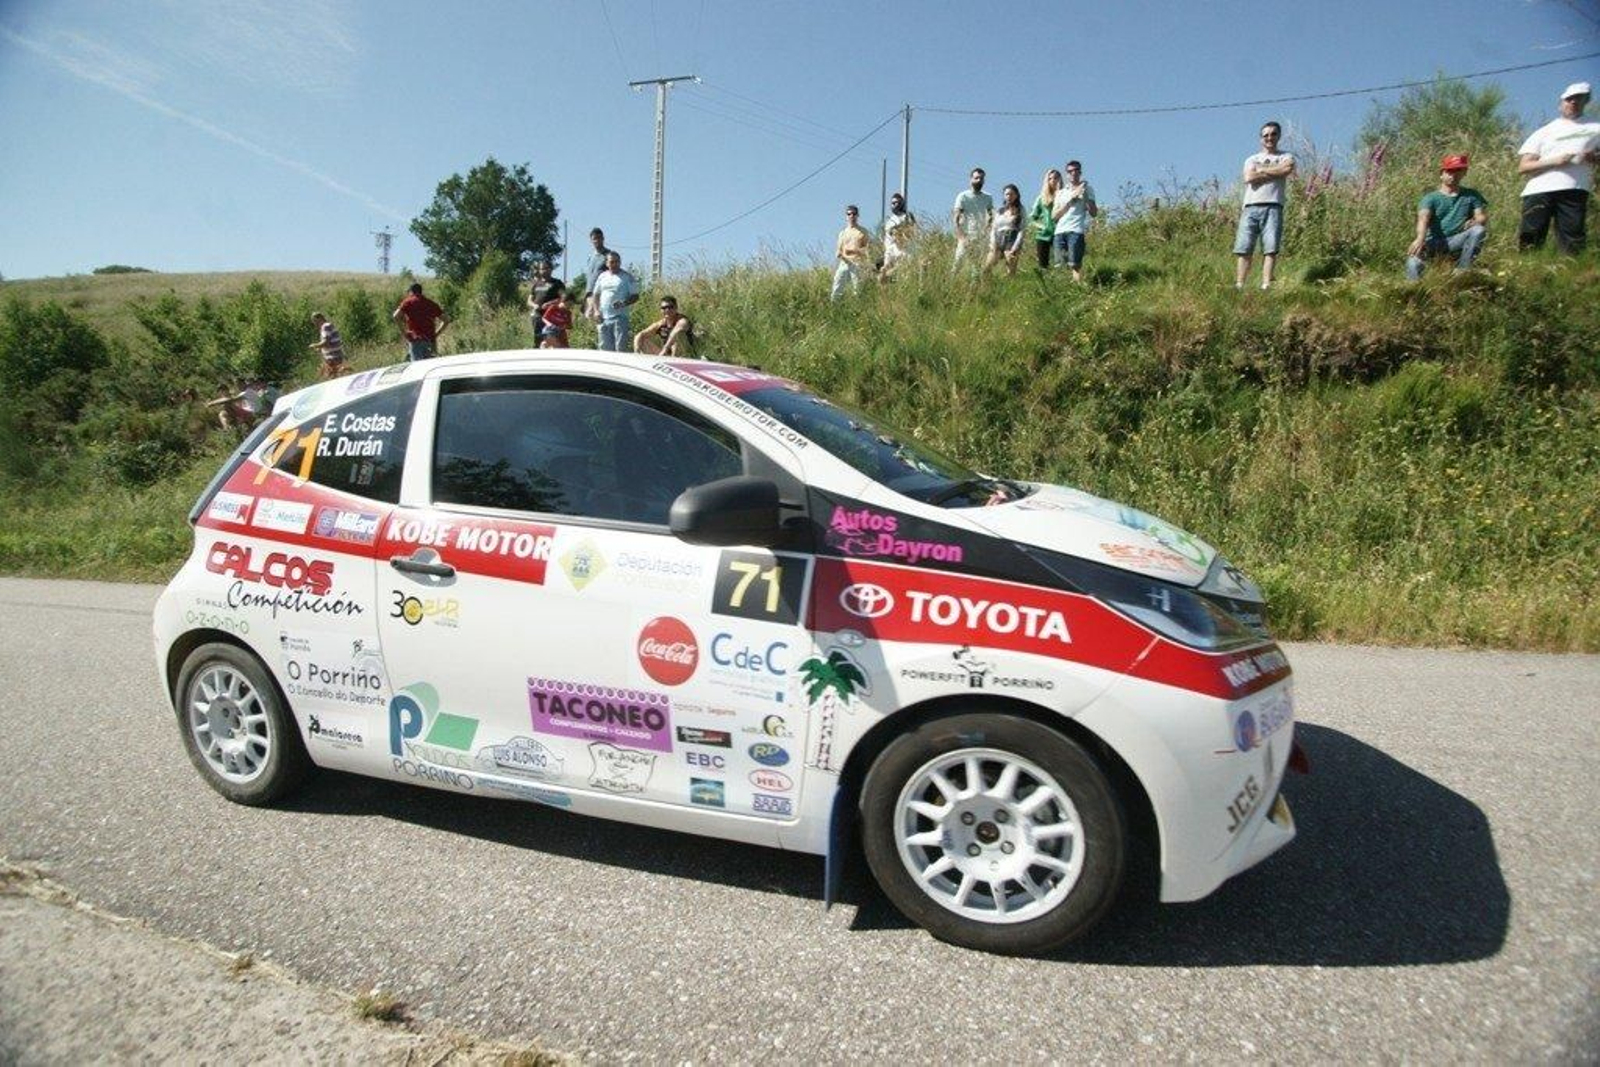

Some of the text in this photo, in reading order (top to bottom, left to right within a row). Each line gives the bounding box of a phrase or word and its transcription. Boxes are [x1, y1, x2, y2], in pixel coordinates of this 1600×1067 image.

[323, 413, 395, 433] E. Costas
[316, 434, 382, 456] R. Durán
[831, 506, 897, 531] Autos
[386, 518, 451, 547] KOBE
[456, 526, 553, 561] MOTOR
[877, 534, 963, 562] Dayron
[205, 541, 334, 596] CALCOS
[227, 580, 363, 619] Competición
[729, 561, 782, 613] 71
[906, 591, 1072, 643] TOYOTA
[287, 660, 381, 690] O Porriño
[901, 669, 966, 685] POWERFIT
[533, 692, 665, 731] TACONEO
[513, 750, 547, 768] ALONSO
[686, 752, 725, 768] EBC
[757, 777, 784, 788] HEL
